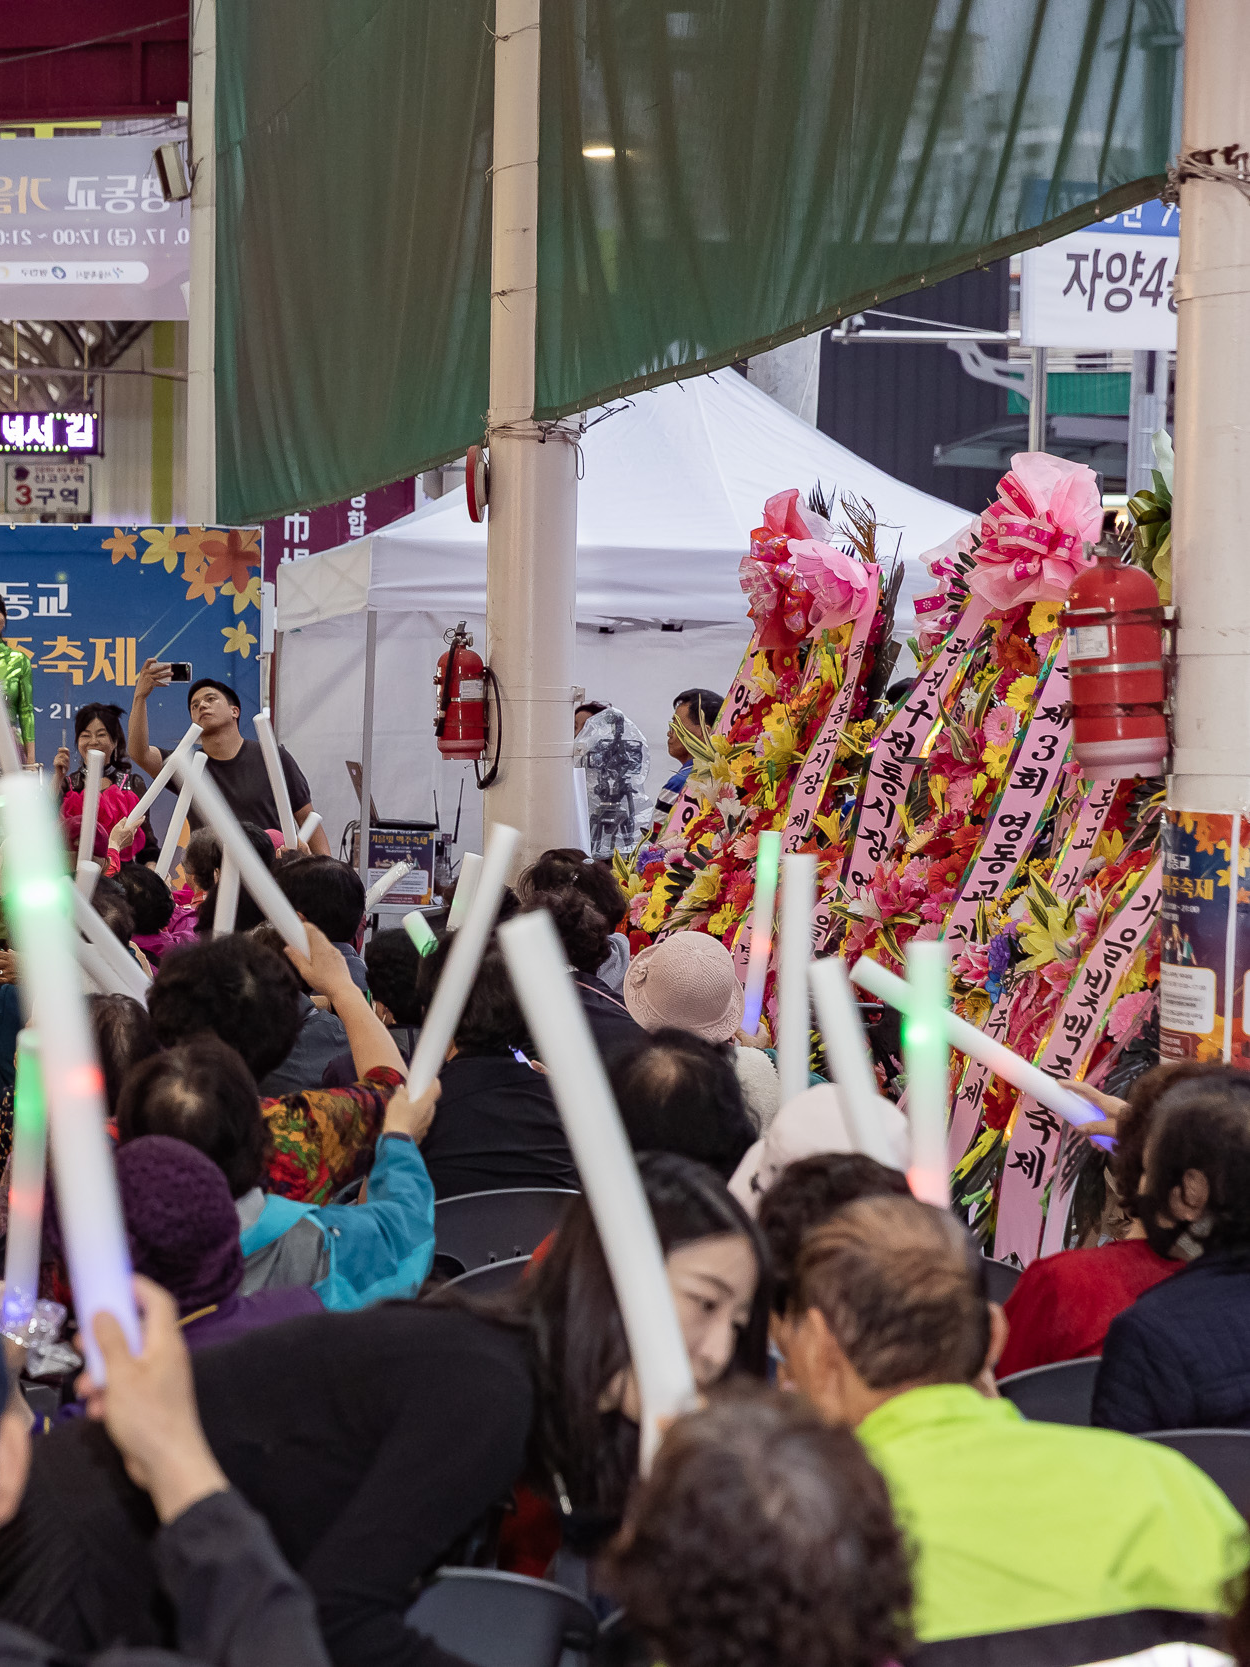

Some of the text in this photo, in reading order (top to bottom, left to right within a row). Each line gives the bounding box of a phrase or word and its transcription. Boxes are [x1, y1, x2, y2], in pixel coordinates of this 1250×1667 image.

[850, 640, 865, 661] 축
[1010, 700, 1071, 798] 제3회
[785, 808, 811, 854] 제3
[961, 811, 1032, 904] 영동교
